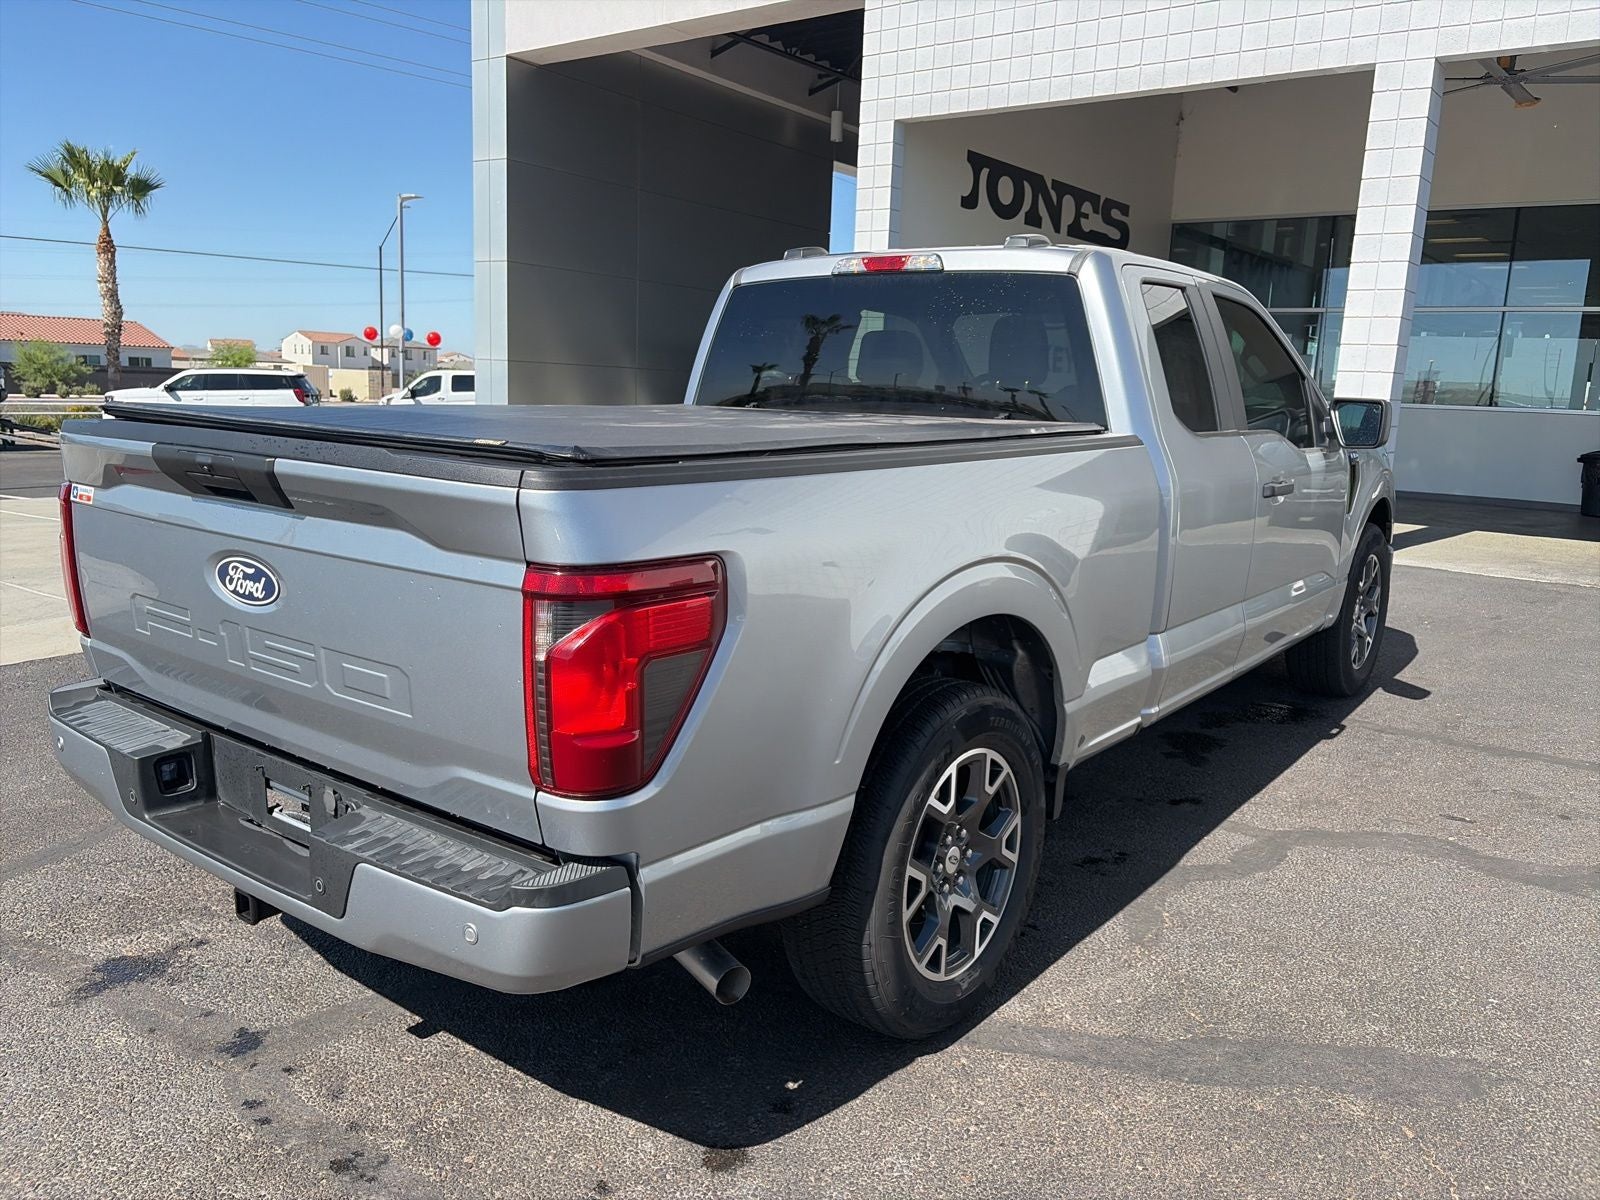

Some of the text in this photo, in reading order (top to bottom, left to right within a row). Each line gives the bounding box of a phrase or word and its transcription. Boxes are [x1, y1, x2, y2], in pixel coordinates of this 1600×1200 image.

[960, 149, 1130, 250] JONES
[225, 561, 266, 599] Ford
[131, 592, 413, 719] F-150
[989, 715, 1031, 746] TERRITORY
